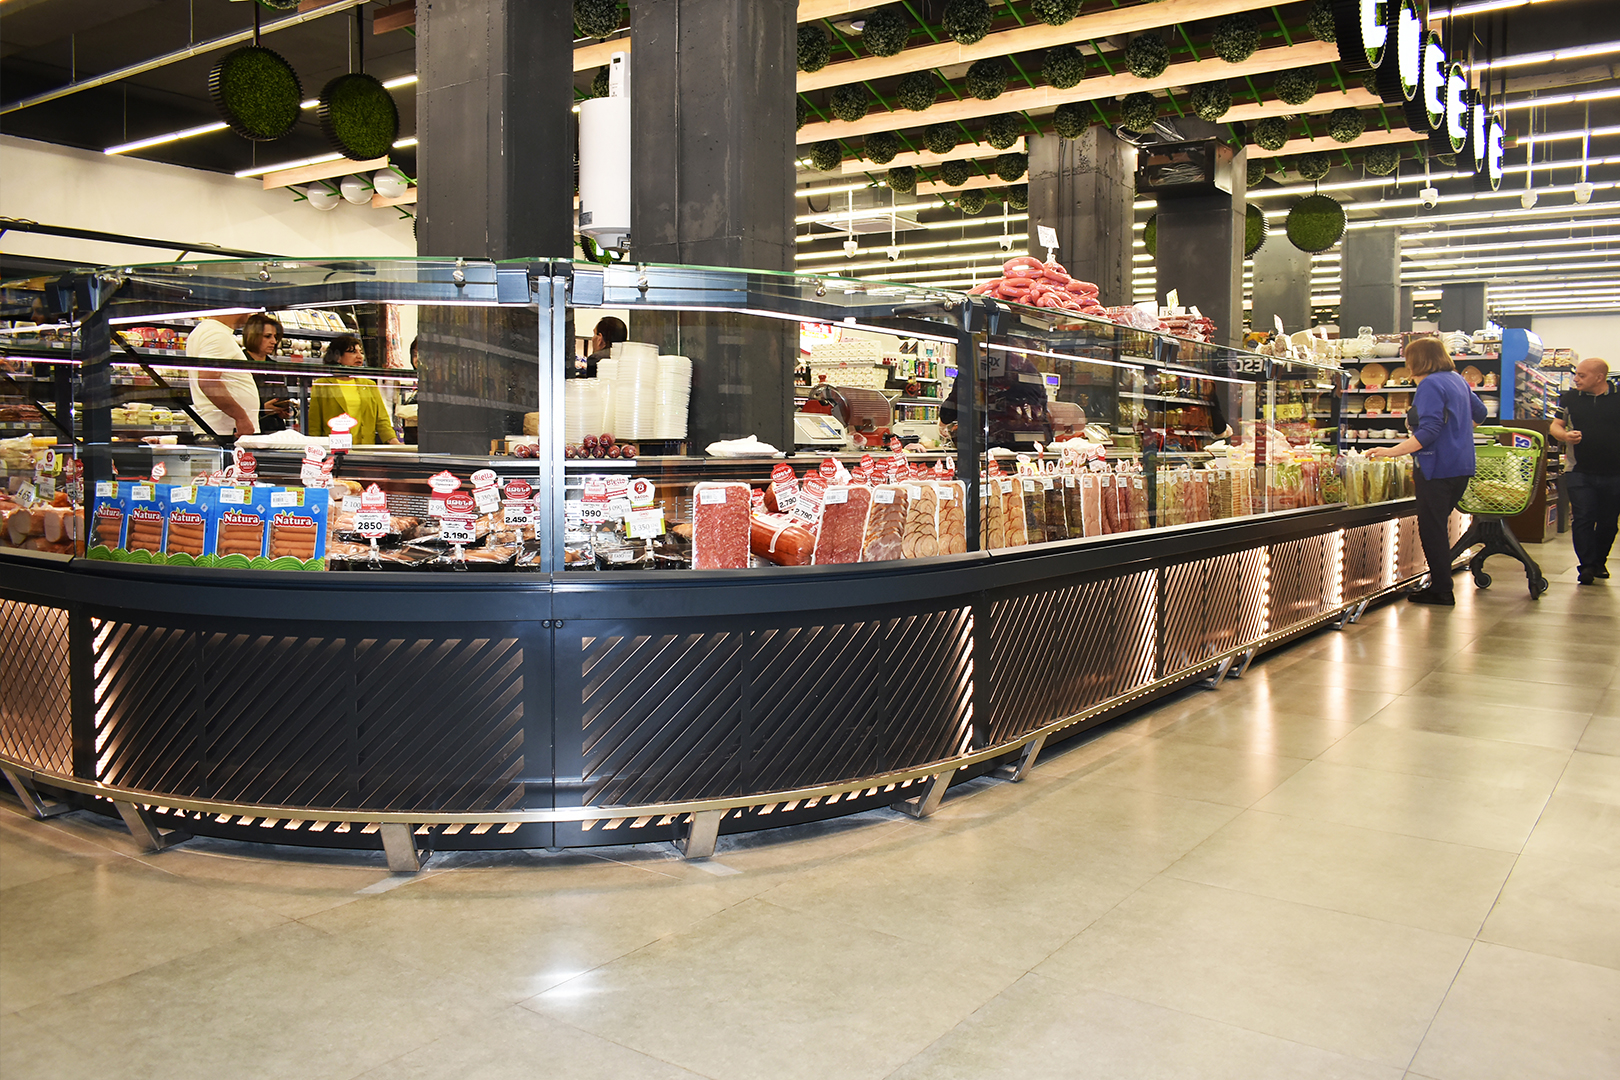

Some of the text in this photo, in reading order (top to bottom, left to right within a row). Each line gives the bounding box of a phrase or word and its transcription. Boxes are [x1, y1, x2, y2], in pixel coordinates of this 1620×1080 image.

[98, 506, 121, 517] Natura
[132, 510, 161, 520] Natura
[581, 509, 602, 518] 1990
[170, 512, 201, 523] Natura
[223, 513, 259, 524] Natura
[274, 515, 312, 526] Natura
[505, 516, 527, 524] 2.450
[357, 521, 383, 530] 2850
[443, 531, 468, 540] 3.190
